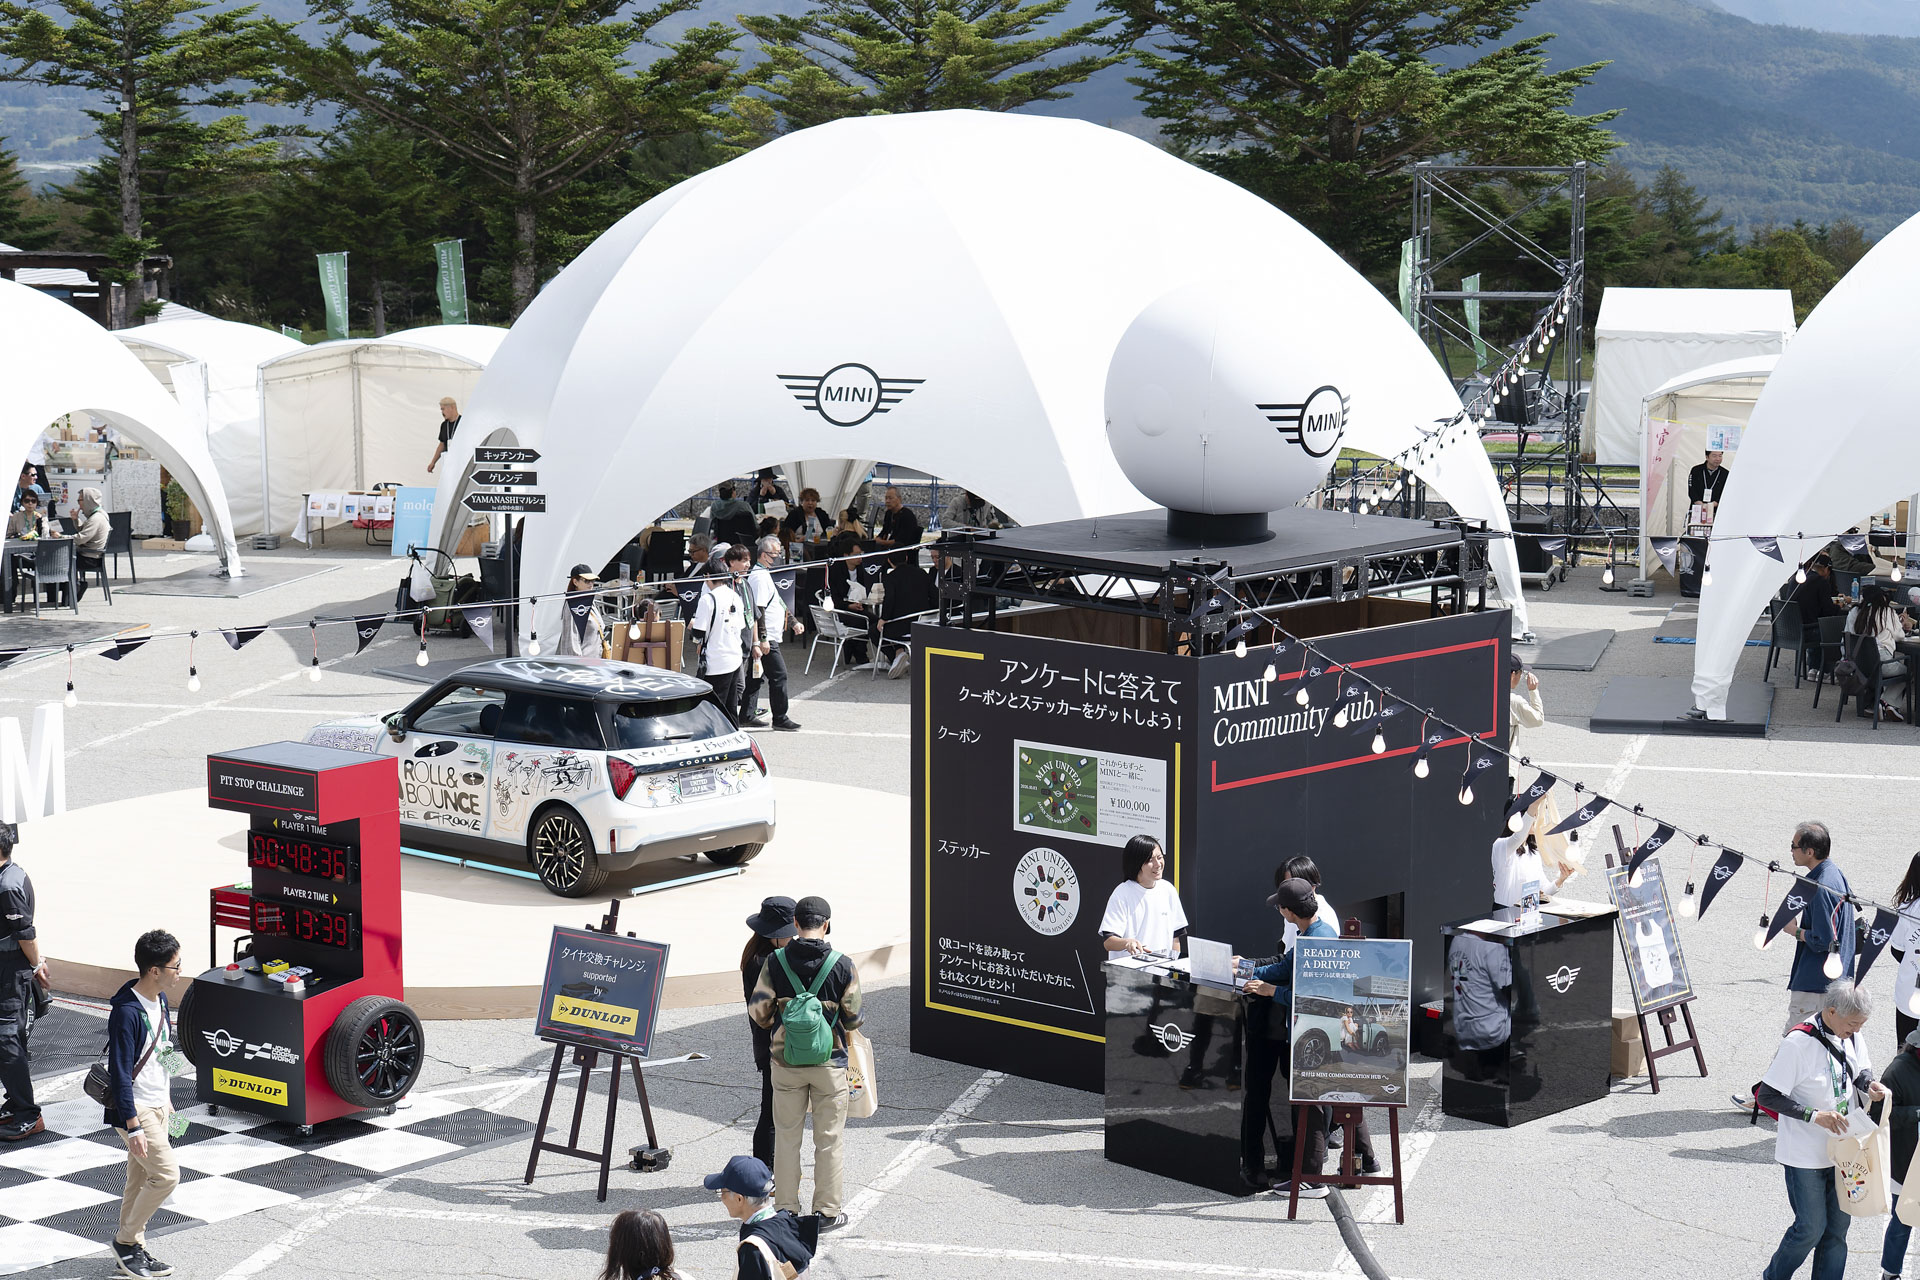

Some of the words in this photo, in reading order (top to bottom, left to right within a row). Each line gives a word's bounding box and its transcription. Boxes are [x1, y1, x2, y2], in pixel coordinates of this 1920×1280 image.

[825, 386, 873, 403] MINI
[1307, 411, 1341, 432] MINI
[484, 450, 534, 461] キッチンカー
[488, 473, 524, 483] ゲレンデ
[471, 495, 545, 505] YAMANASHIマルシェ
[1000, 658, 1182, 705] アンケートに答えて
[1213, 677, 1270, 714] MINI
[958, 686, 1182, 731] クーポンとステッカーをゲットしよう！
[1213, 703, 1330, 747] Community
[1333, 691, 1378, 728] ub.
[937, 725, 982, 744] クーポン
[679, 755, 720, 767] COOPER
[723, 753, 728, 761] S
[1100, 758, 1147, 773] これからもずっと、
[1035, 761, 1054, 781] MINI
[1055, 760, 1082, 789] UNITED.
[1100, 768, 1144, 782] MINIと一緒に。
[219, 774, 234, 787] PIT
[234, 776, 255, 790] STOP
[255, 780, 304, 797] CHALLENGE
[405, 782, 481, 816] BOUNCE
[1110, 797, 1151, 812] ¥100,000
[281, 820, 305, 832] PLAYER
[311, 824, 327, 836] TIME
[399, 810, 419, 820] HE
[424, 811, 482, 832] GROOVE
[253, 835, 345, 878] 00:48:36
[937, 839, 991, 859] ステッカー
[1017, 851, 1040, 877] MINI
[1043, 850, 1077, 888] UNITED.
[283, 886, 307, 899] PLAYER
[307, 889, 312, 900] 2
[312, 891, 329, 902] TIME
[1020, 903, 1032, 921] JAPAN
[1051, 924, 1064, 933] MINI
[939, 937, 1026, 962] QRコードを読み取って
[1303, 948, 1339, 958] READY
[1340, 949, 1361, 959] FOR
[561, 947, 647, 973] タイヤ交換チャレンジ.
[1303, 960, 1311, 969] A
[1313, 960, 1351, 970] DRIVE?
[583, 970, 617, 983] supported
[939, 952, 1076, 989] アンケートにお答えいただいた方に、
[593, 985, 603, 997] by
[569, 1006, 632, 1026] DUNLOP
[215, 1038, 230, 1048] MINI
[1164, 1032, 1180, 1043] MINI
[272, 1045, 291, 1053] JOHN
[272, 1049, 299, 1060] COOPER
[272, 1055, 296, 1064] WORKS
[228, 1078, 282, 1097] DUNLOP
